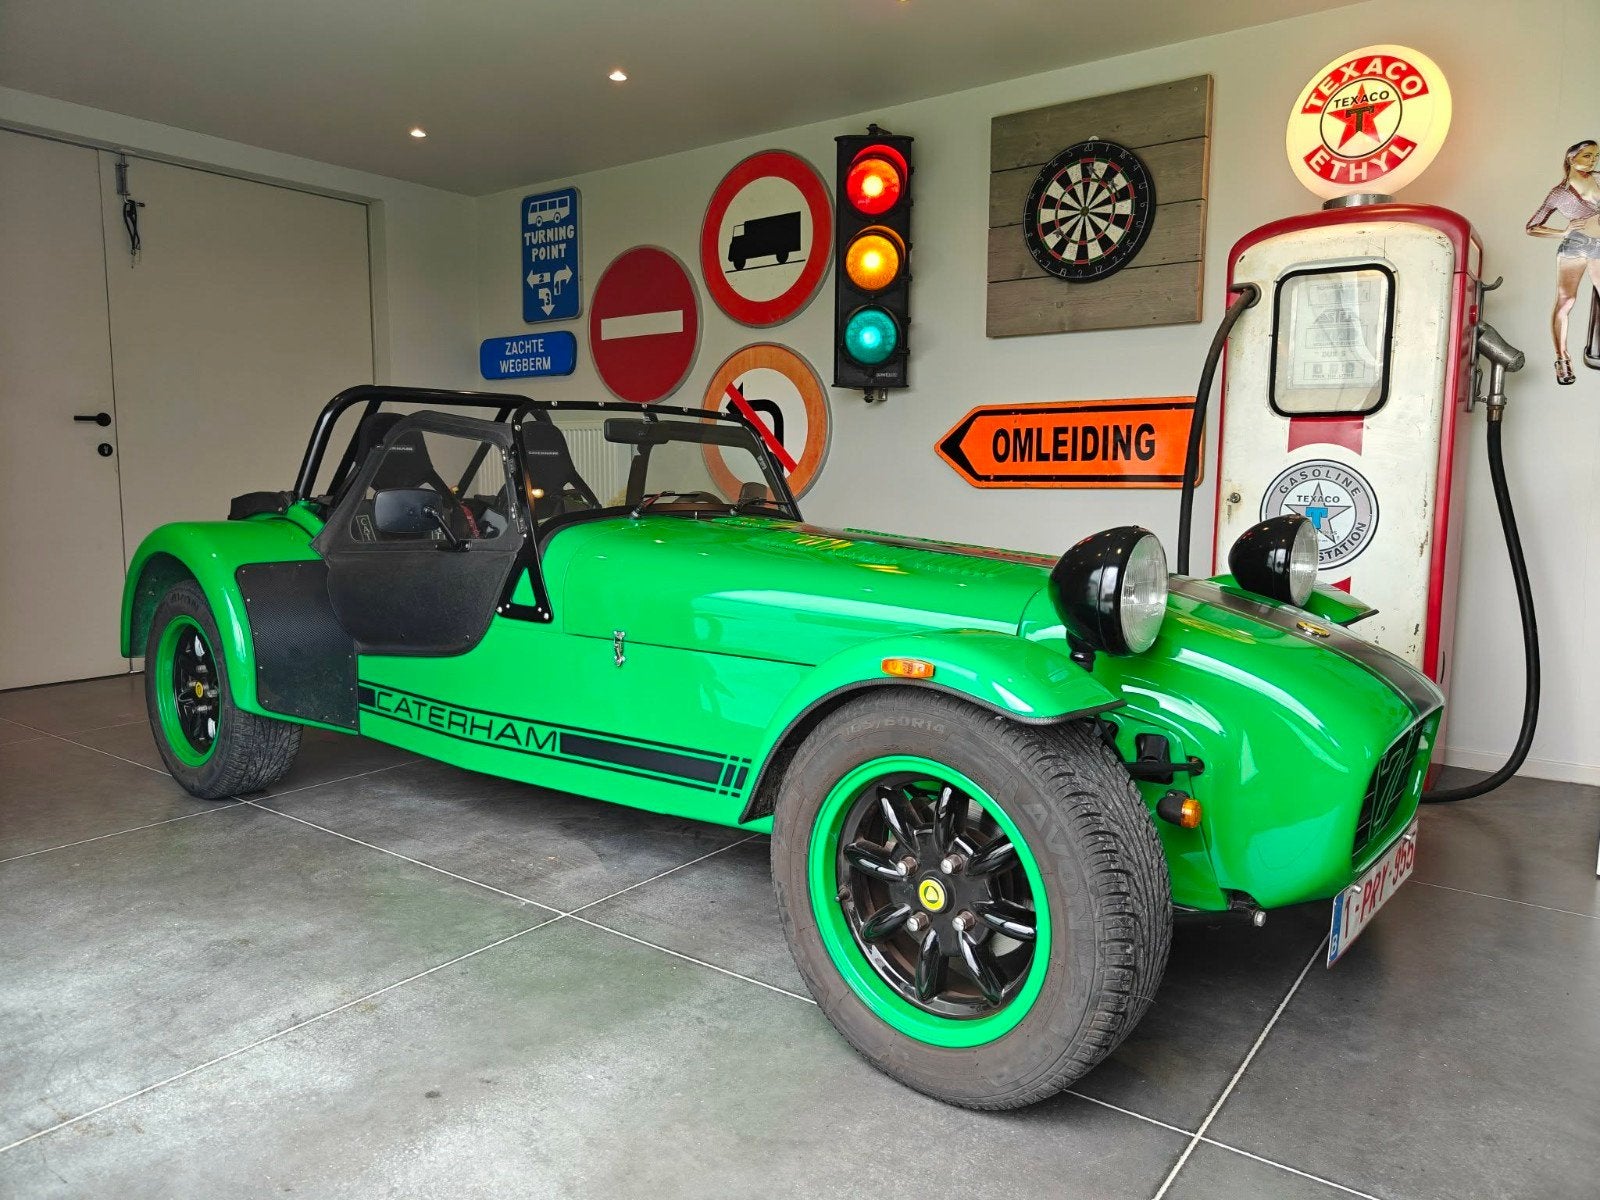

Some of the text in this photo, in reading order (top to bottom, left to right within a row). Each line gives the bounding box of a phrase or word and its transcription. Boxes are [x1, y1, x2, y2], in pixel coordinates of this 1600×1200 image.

[1305, 57, 1423, 109] TEXACO
[1334, 90, 1390, 109] TEXACO
[1346, 105, 1374, 133] T
[1309, 145, 1413, 182] ETHYL
[524, 225, 575, 246] TURNING
[532, 243, 567, 262] POINT
[539, 273, 545, 283] 2
[545, 292, 551, 306] 3
[505, 339, 545, 356] ZACHTE
[499, 356, 551, 373] WEGBERM
[992, 423, 1156, 463] OMLEIDING
[1279, 468, 1361, 497] GASOLINE
[1297, 494, 1340, 503] TEXACO
[1305, 507, 1329, 530] T
[1318, 522, 1367, 562] STATION
[375, 691, 561, 753] CATERHAM
